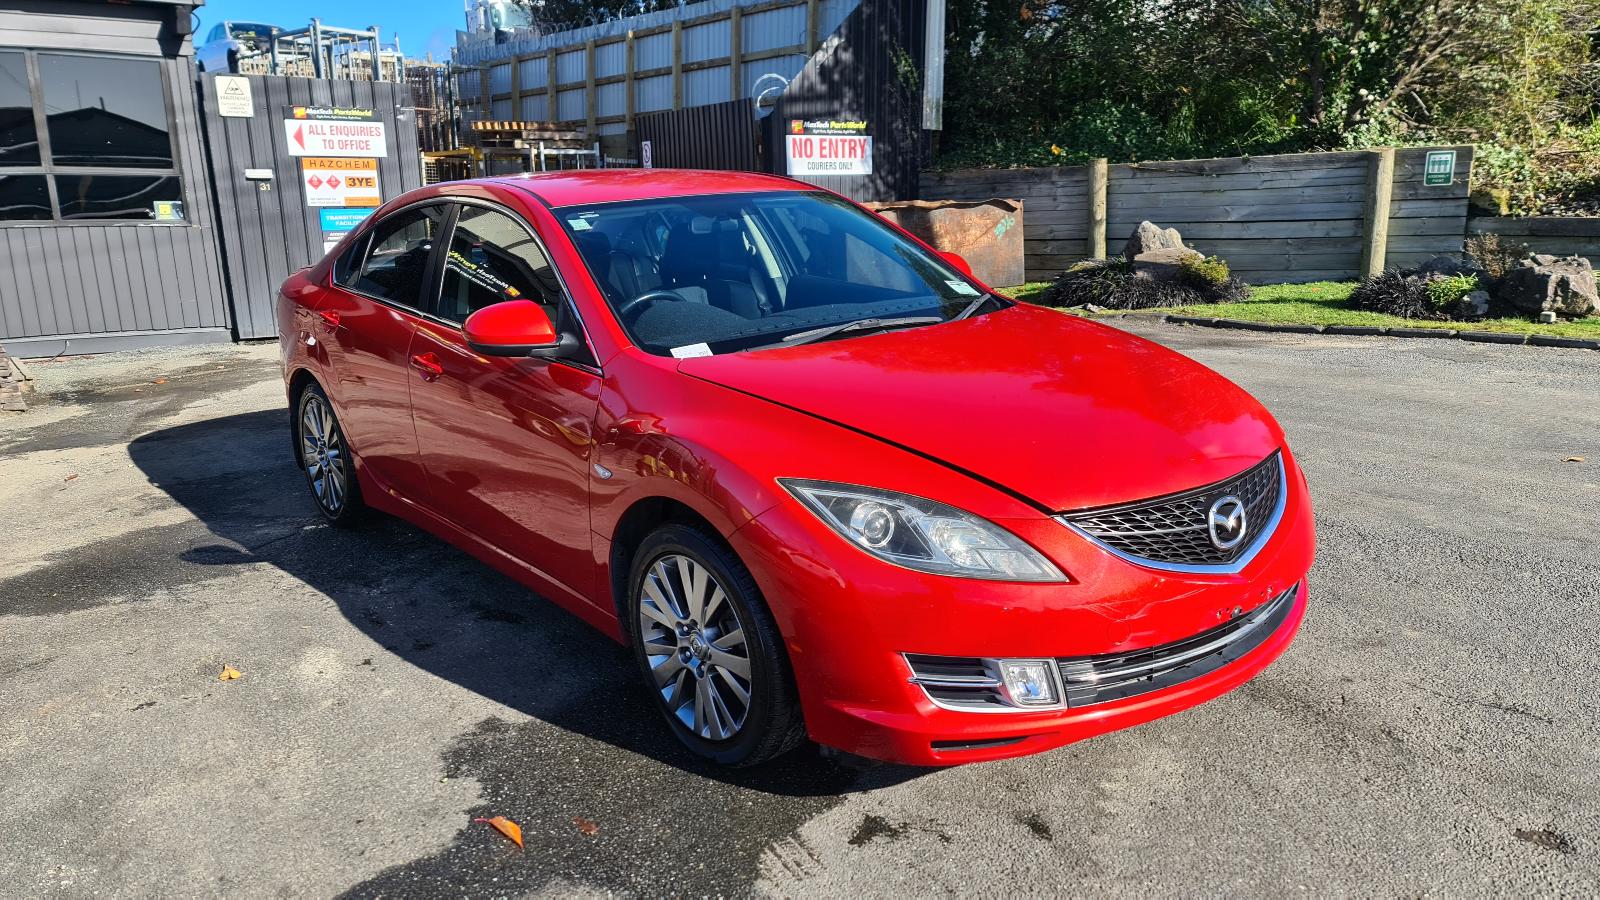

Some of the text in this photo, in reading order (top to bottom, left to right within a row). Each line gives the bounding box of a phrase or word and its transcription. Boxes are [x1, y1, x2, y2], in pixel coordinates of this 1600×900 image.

[306, 107, 373, 117] MaxTech PartsWorld
[803, 120, 867, 129] MaxTech PartsWorld
[308, 124, 381, 137] ALL ENQUIRIES
[322, 139, 371, 150] TO OFFICE
[791, 137, 867, 159] NO ENTRY
[309, 159, 370, 169] HAZCHEM
[807, 161, 853, 171] COURIERS ONLY
[259, 182, 271, 191] 31
[349, 177, 373, 187] 3YE
